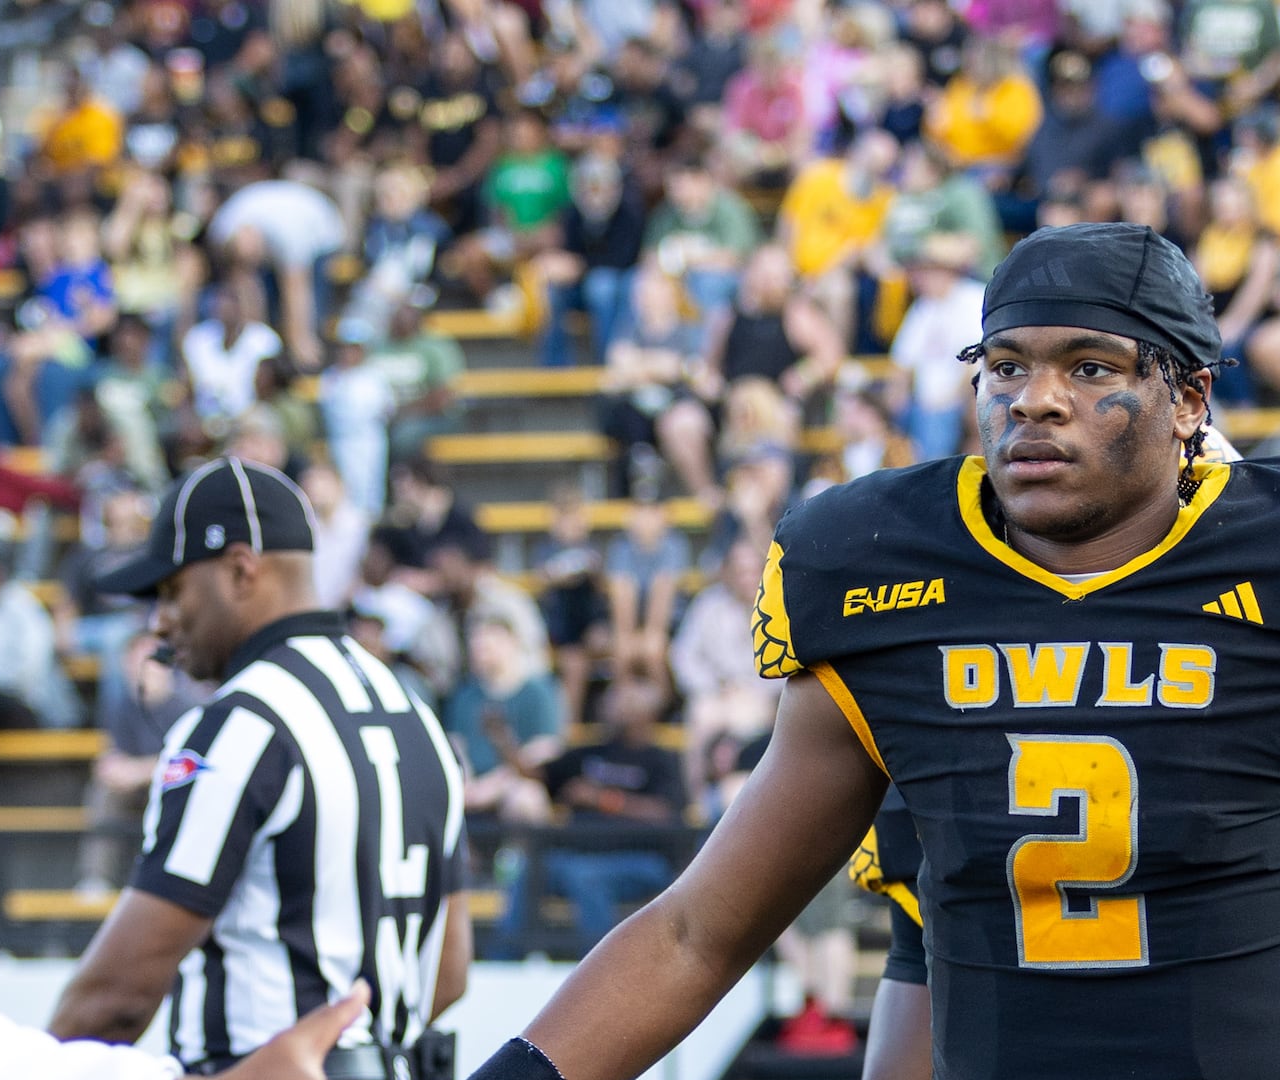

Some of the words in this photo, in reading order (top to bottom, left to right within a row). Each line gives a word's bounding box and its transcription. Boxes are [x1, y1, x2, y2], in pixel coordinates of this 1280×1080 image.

[938, 641, 1217, 709] OWLS
[359, 726, 429, 898] L
[1005, 733, 1150, 969] 2
